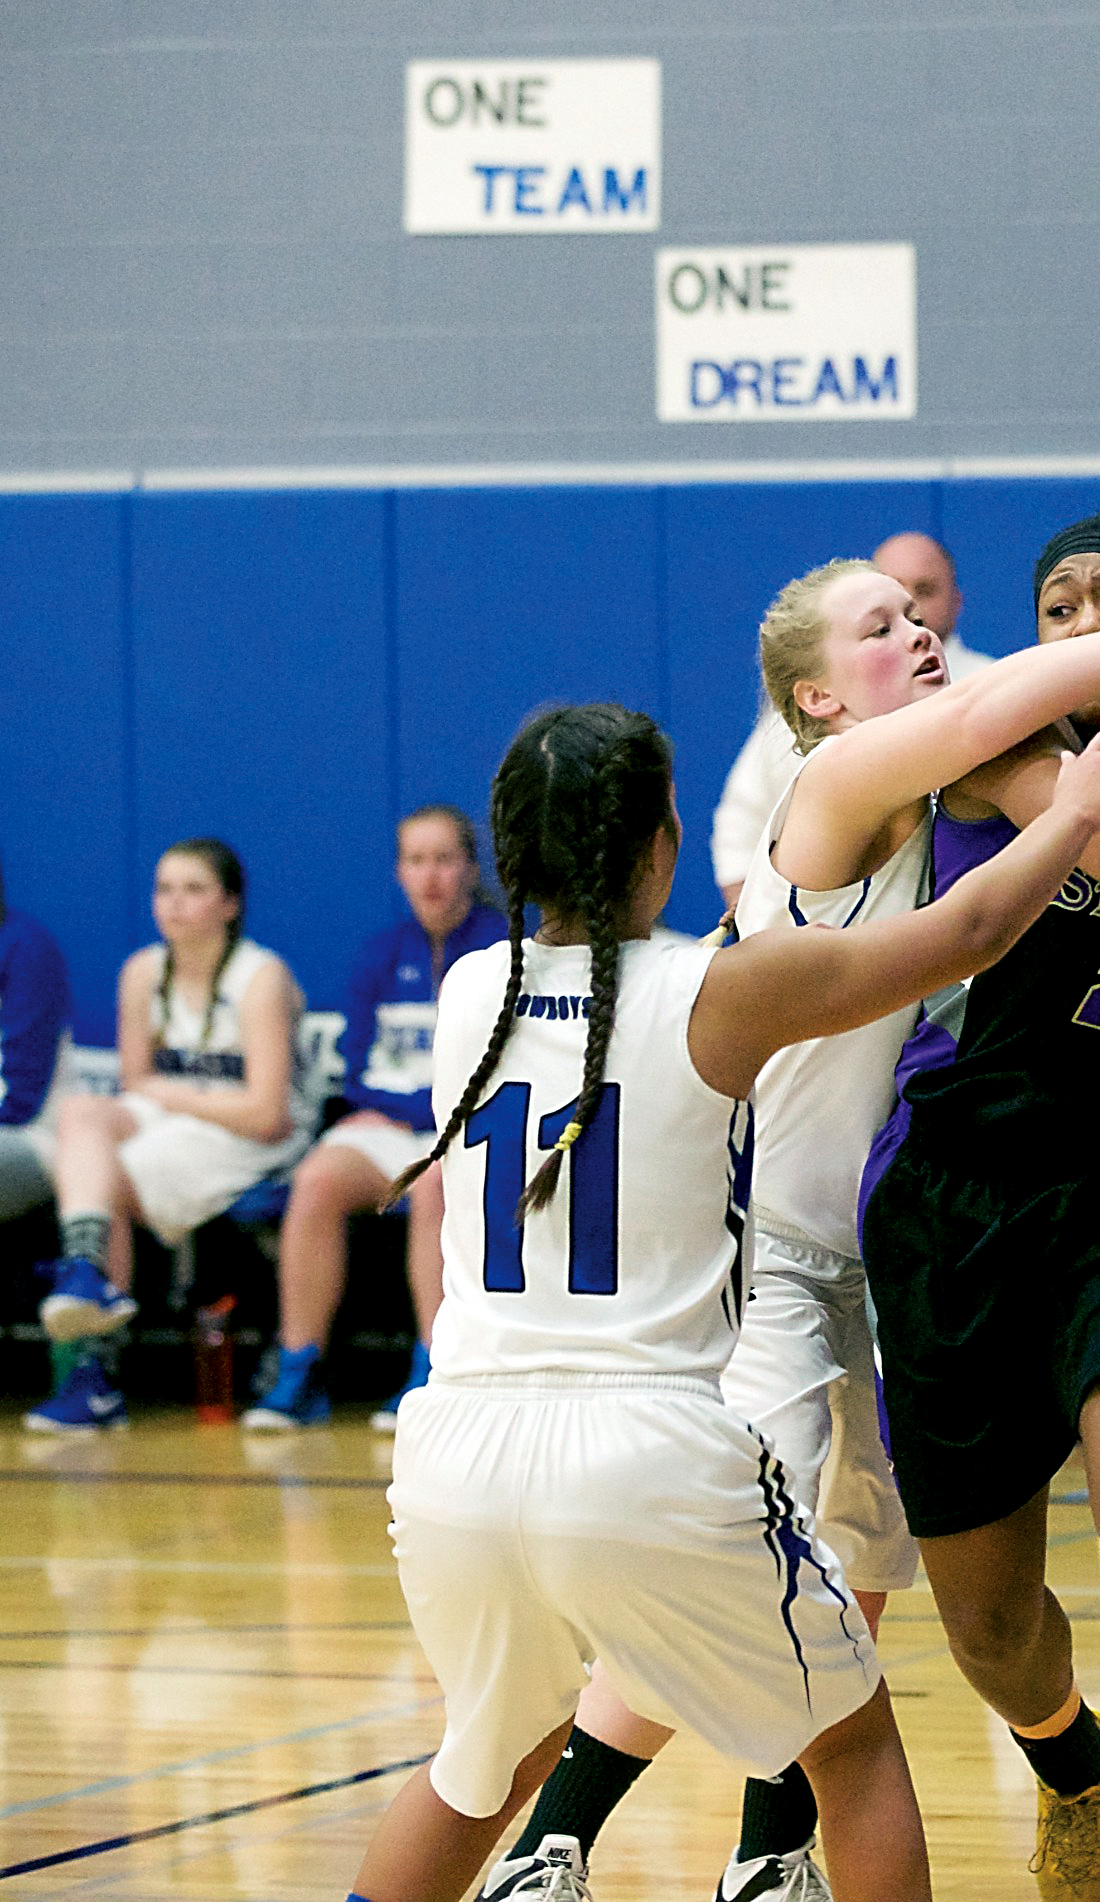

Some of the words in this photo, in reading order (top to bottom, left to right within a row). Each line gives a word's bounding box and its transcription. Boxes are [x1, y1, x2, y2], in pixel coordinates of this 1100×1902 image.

[423, 76, 547, 128] ONE
[473, 164, 649, 215] TEAM
[667, 261, 792, 315] ONE
[689, 354, 899, 409] DREAM
[514, 993, 594, 1021] OWBOYS
[464, 1081, 621, 1295] 11
[547, 1847, 572, 1860] NIKE
